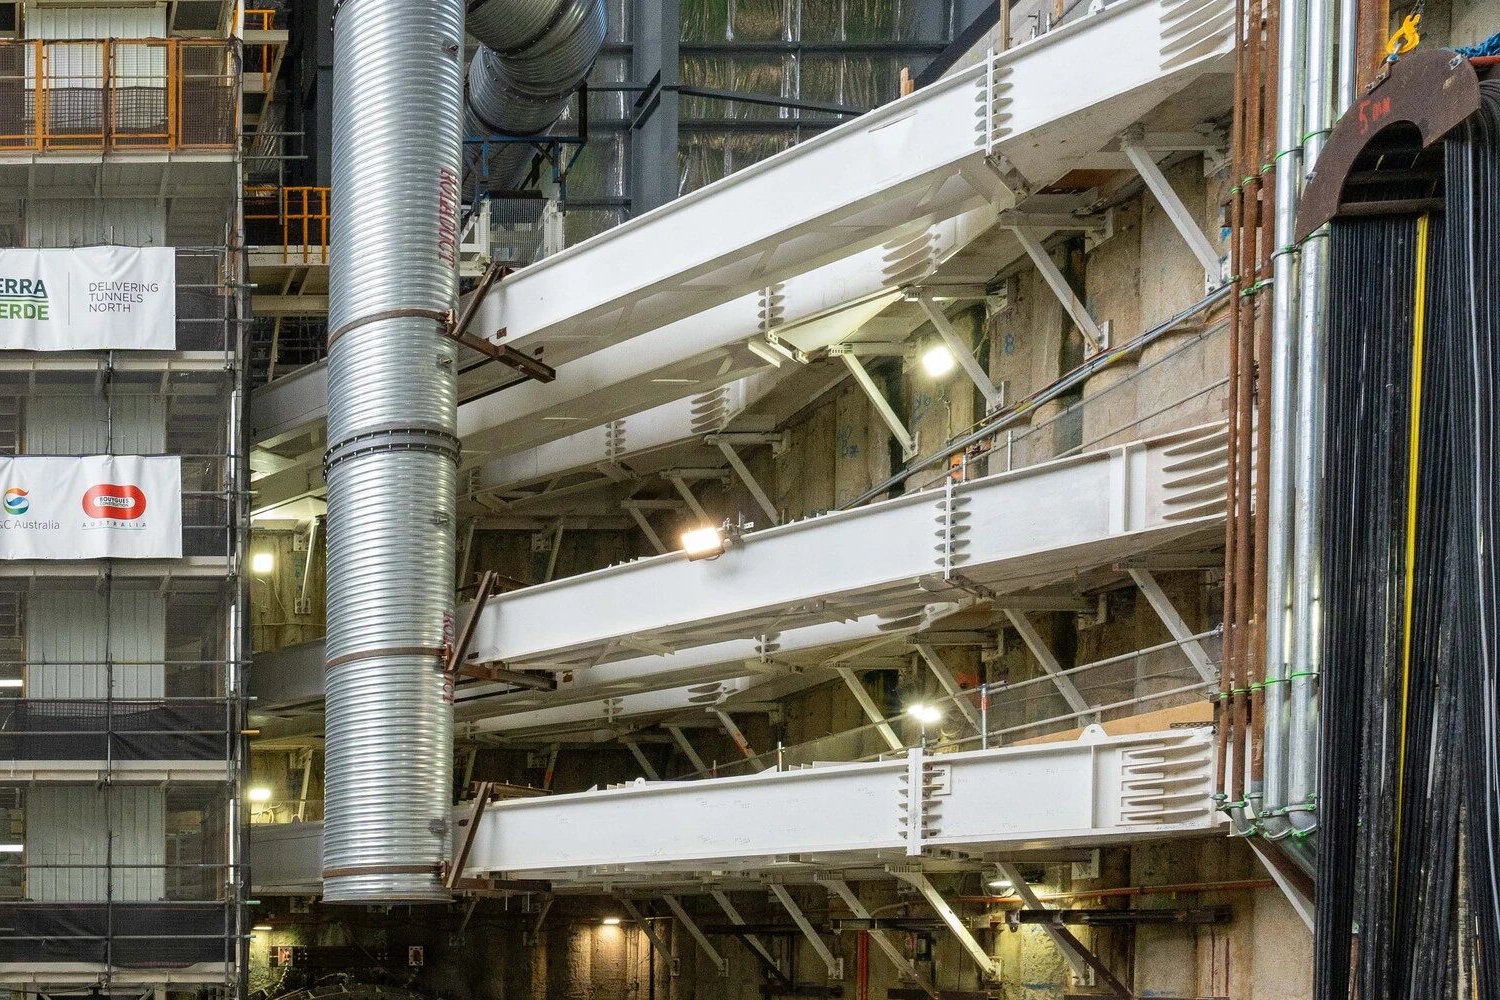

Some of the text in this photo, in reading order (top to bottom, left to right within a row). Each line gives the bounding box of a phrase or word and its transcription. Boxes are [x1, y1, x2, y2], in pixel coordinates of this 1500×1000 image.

[89, 281, 159, 293] DELIVERING
[89, 292, 143, 304] TUNNELS
[89, 303, 131, 313] NORTH
[99, 496, 130, 504] BOUYGUES
[14, 520, 60, 530] Australia
[82, 520, 147, 528] AUSTRALIA
